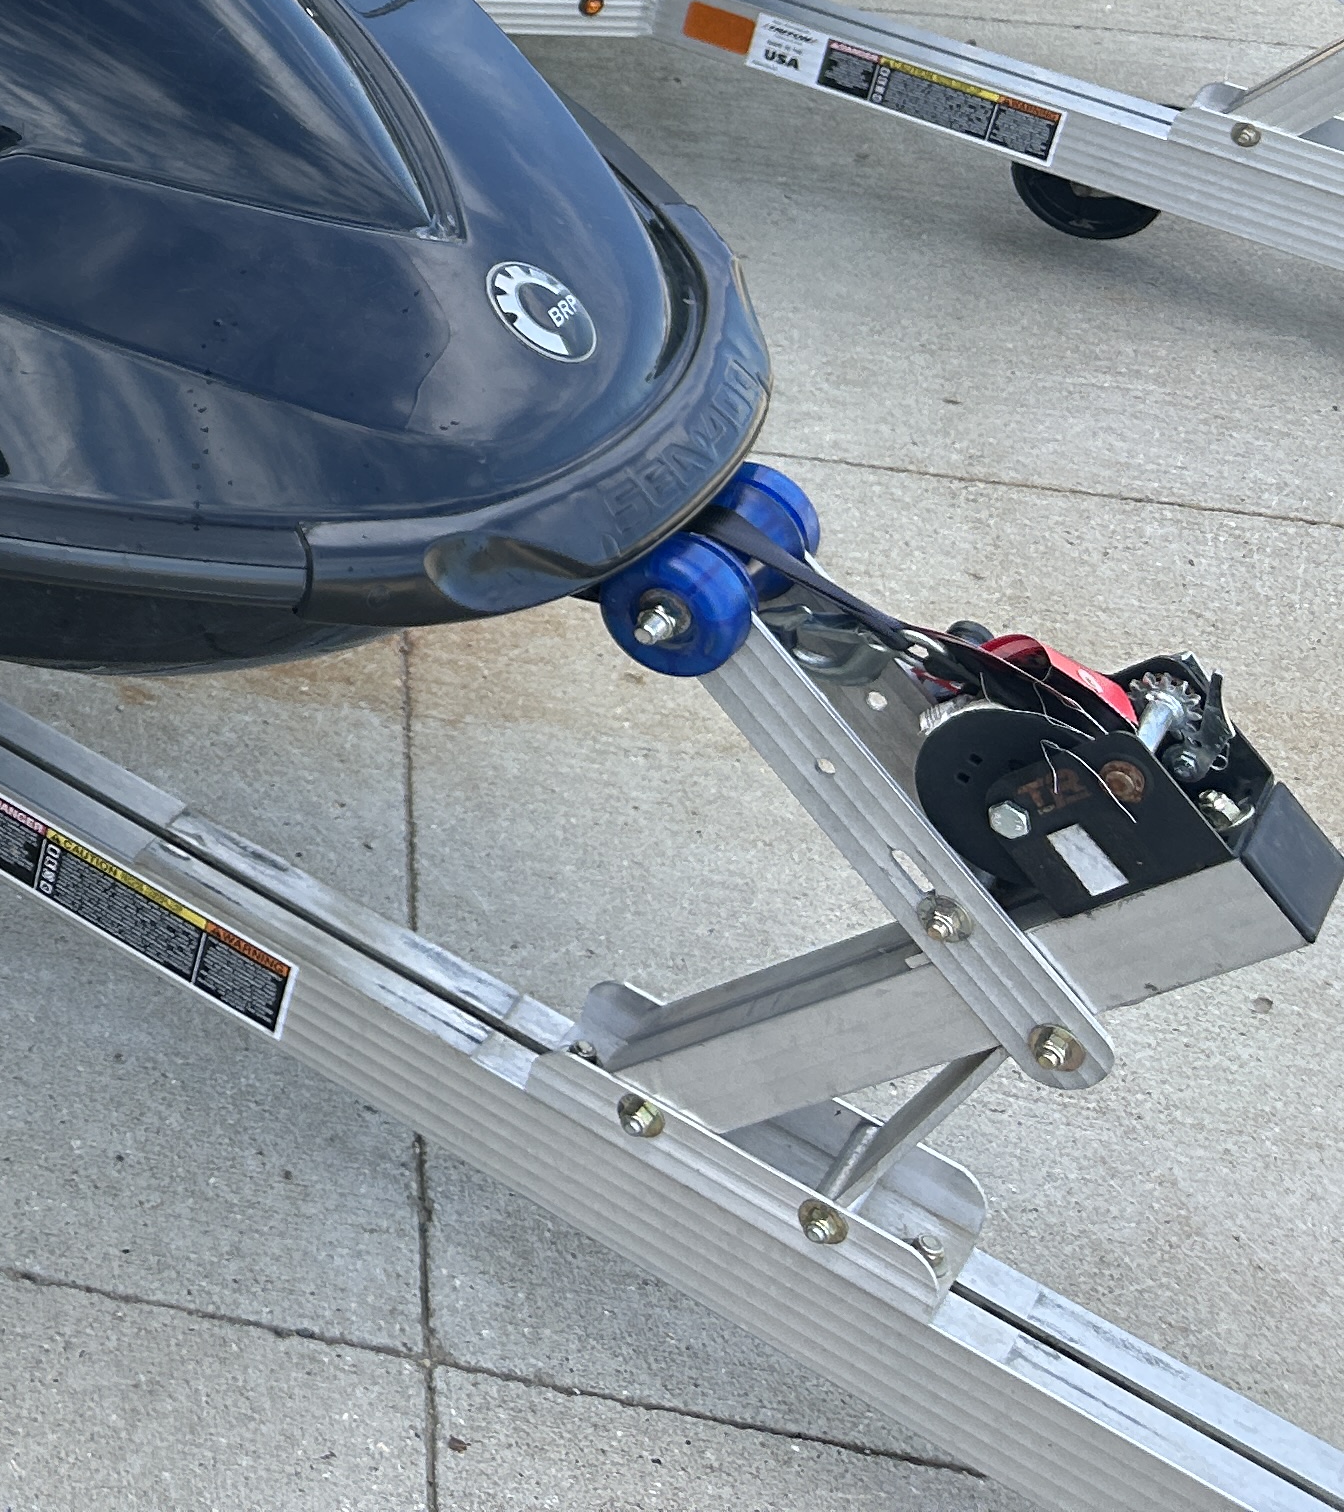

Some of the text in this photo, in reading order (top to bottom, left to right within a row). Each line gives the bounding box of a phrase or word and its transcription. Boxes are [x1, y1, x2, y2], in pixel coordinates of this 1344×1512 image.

[764, 48, 800, 71] USA
[547, 294, 578, 327] BRP
[63, 840, 118, 877] CAUTION
[220, 930, 286, 975] WARNING
